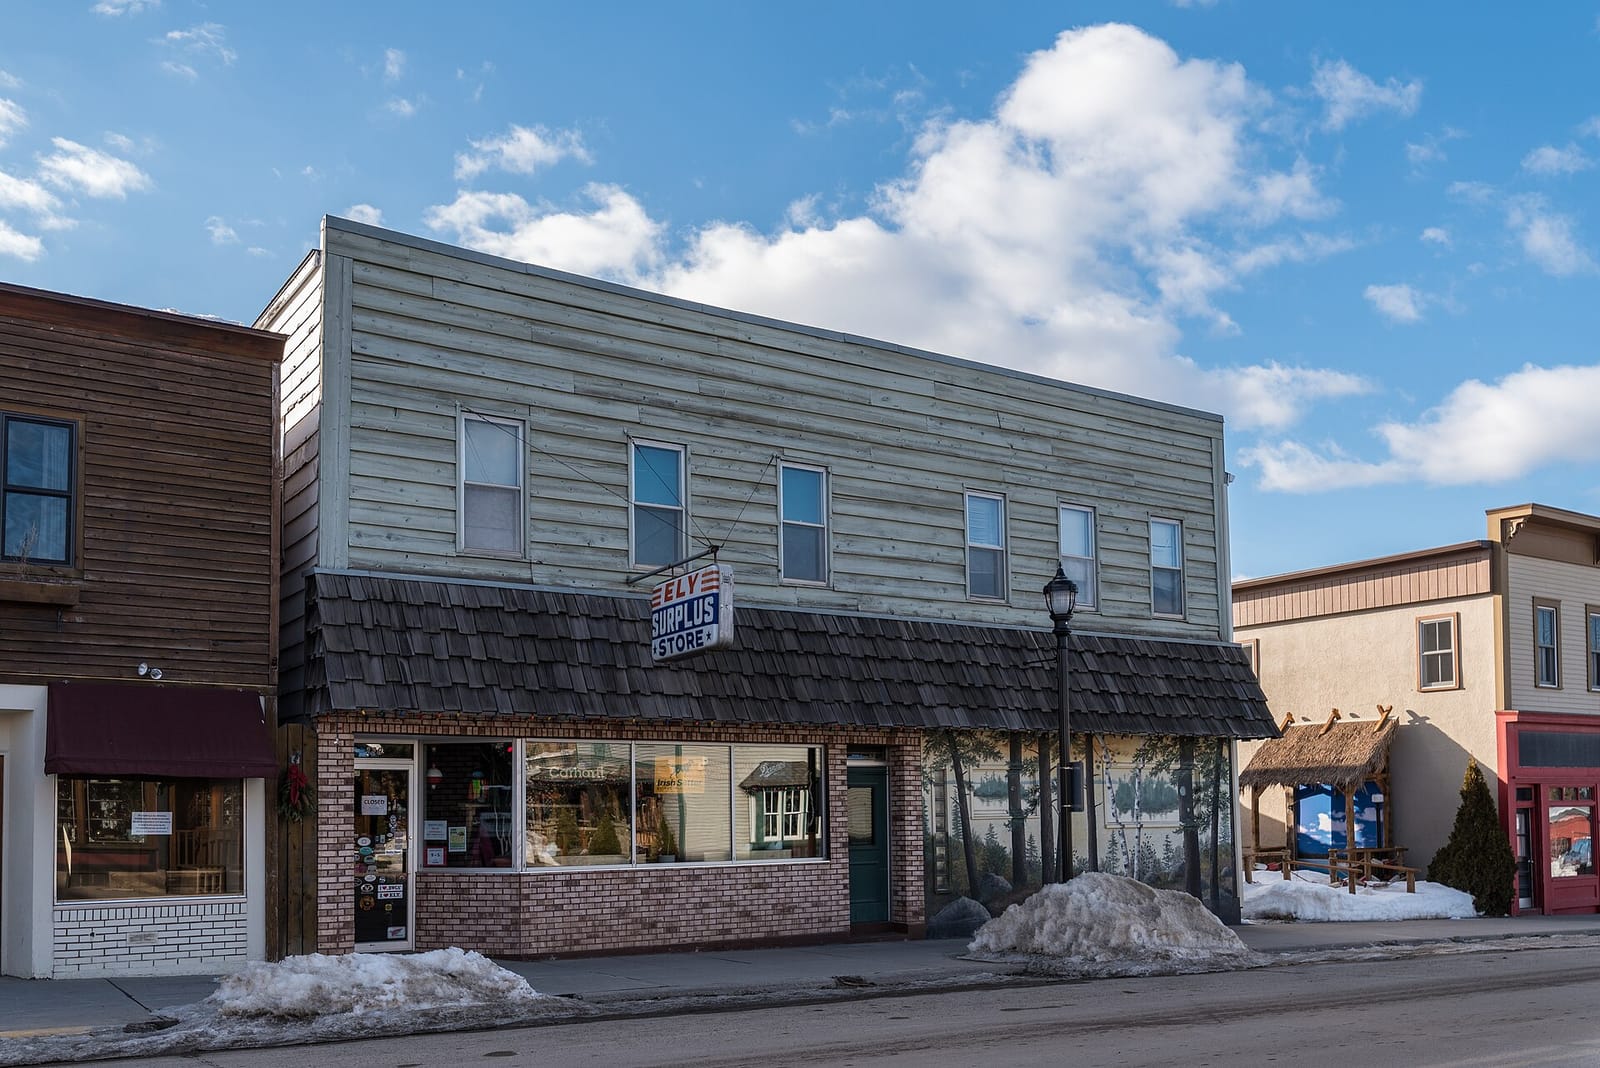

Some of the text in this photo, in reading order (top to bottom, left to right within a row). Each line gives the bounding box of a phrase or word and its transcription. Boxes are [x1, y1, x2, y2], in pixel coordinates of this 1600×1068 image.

[664, 573, 699, 603] ELY
[652, 596, 714, 638] SURPLUS
[658, 629, 704, 657] STORE
[657, 778, 676, 787] Irish
